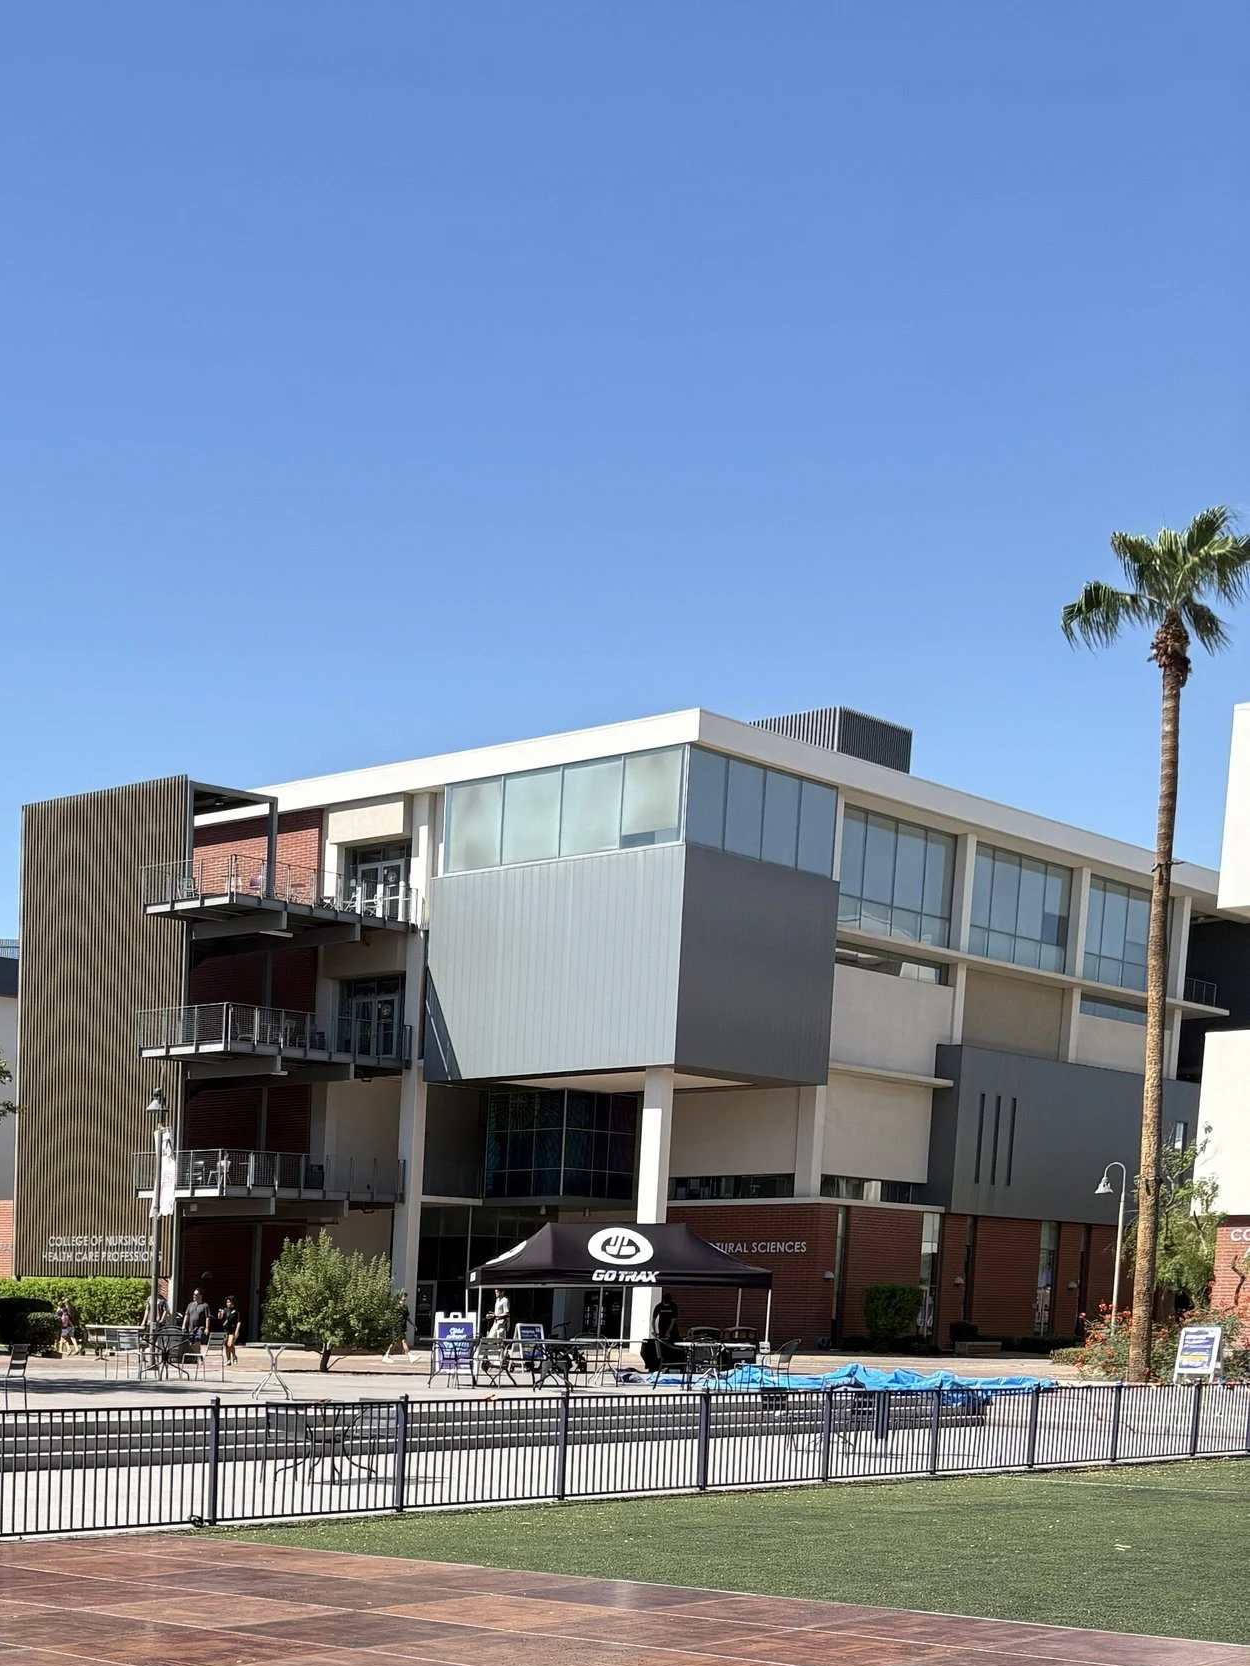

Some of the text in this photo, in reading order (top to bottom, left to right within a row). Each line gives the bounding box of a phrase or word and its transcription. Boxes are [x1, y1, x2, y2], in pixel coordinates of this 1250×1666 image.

[49, 1236, 89, 1247] COLLEGE
[90, 1236, 103, 1247] OF
[106, 1235, 146, 1247] NURSING
[715, 1241, 807, 1254] TURAL SCIENCES
[42, 1251, 72, 1262] HEALTH
[75, 1251, 99, 1262] CARE
